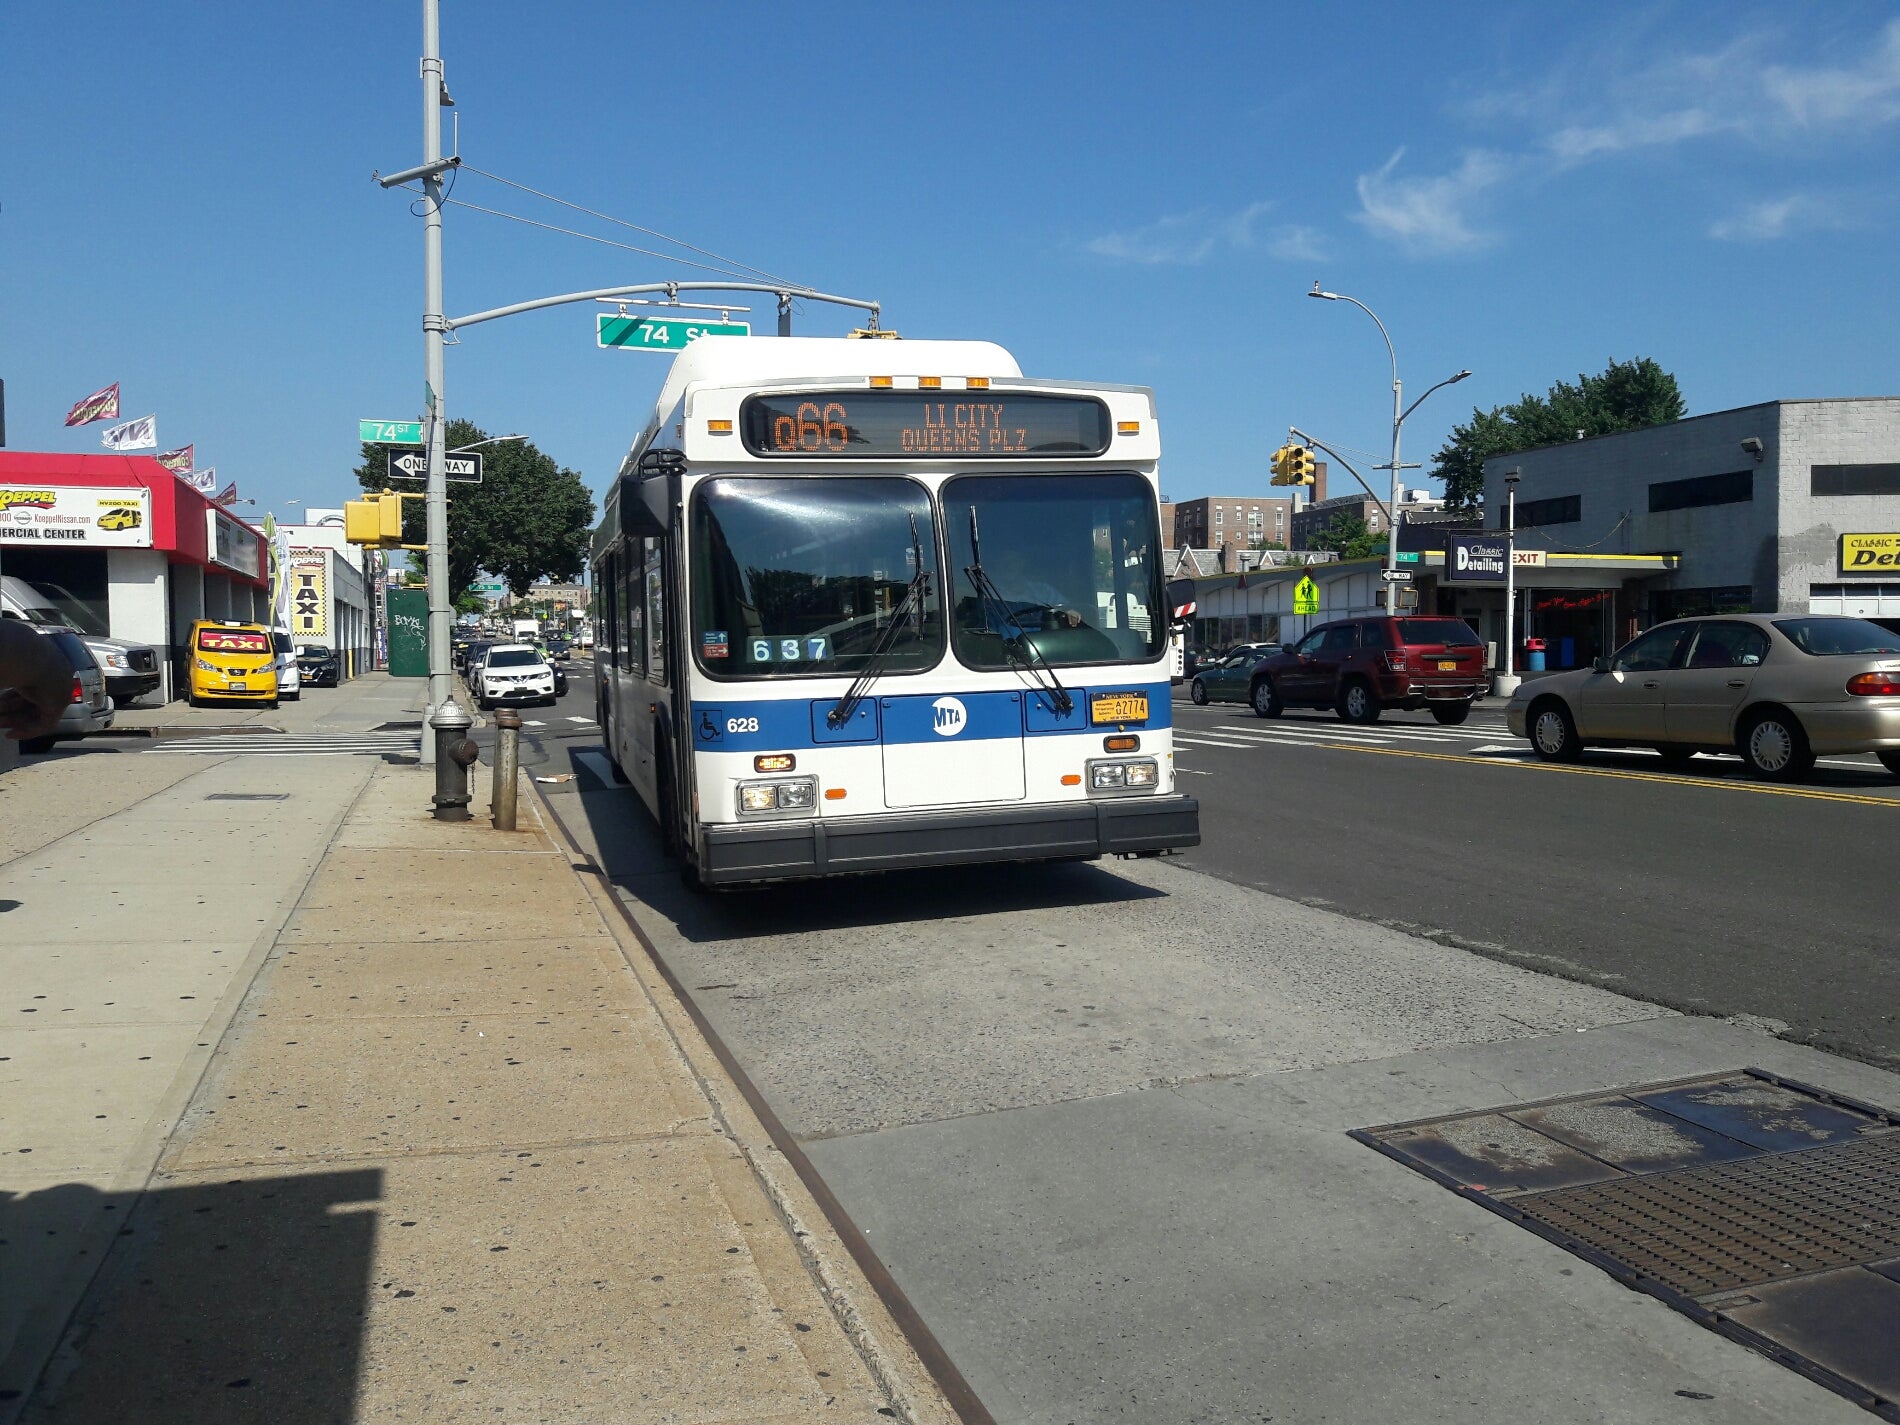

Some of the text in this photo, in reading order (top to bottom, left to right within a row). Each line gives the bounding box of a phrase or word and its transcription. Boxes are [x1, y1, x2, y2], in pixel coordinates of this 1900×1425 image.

[640, 325, 669, 343] 74
[925, 404, 1003, 428] LI CITY
[373, 423, 410, 440] 74 ST
[774, 402, 848, 451] Q66
[902, 428, 1028, 451] QUEENS PLZ
[43, 529, 86, 539] CENTER
[1470, 545, 1504, 555] Classic
[1850, 540, 1892, 550] CLASSIC
[290, 557, 325, 568] KOEPPEL
[1457, 546, 1504, 574] Detailing
[1512, 553, 1539, 564] EXIT
[295, 574, 319, 628] TAXI
[203, 639, 264, 650] TAXI
[727, 717, 759, 733] 628
[933, 706, 961, 729] MTA
